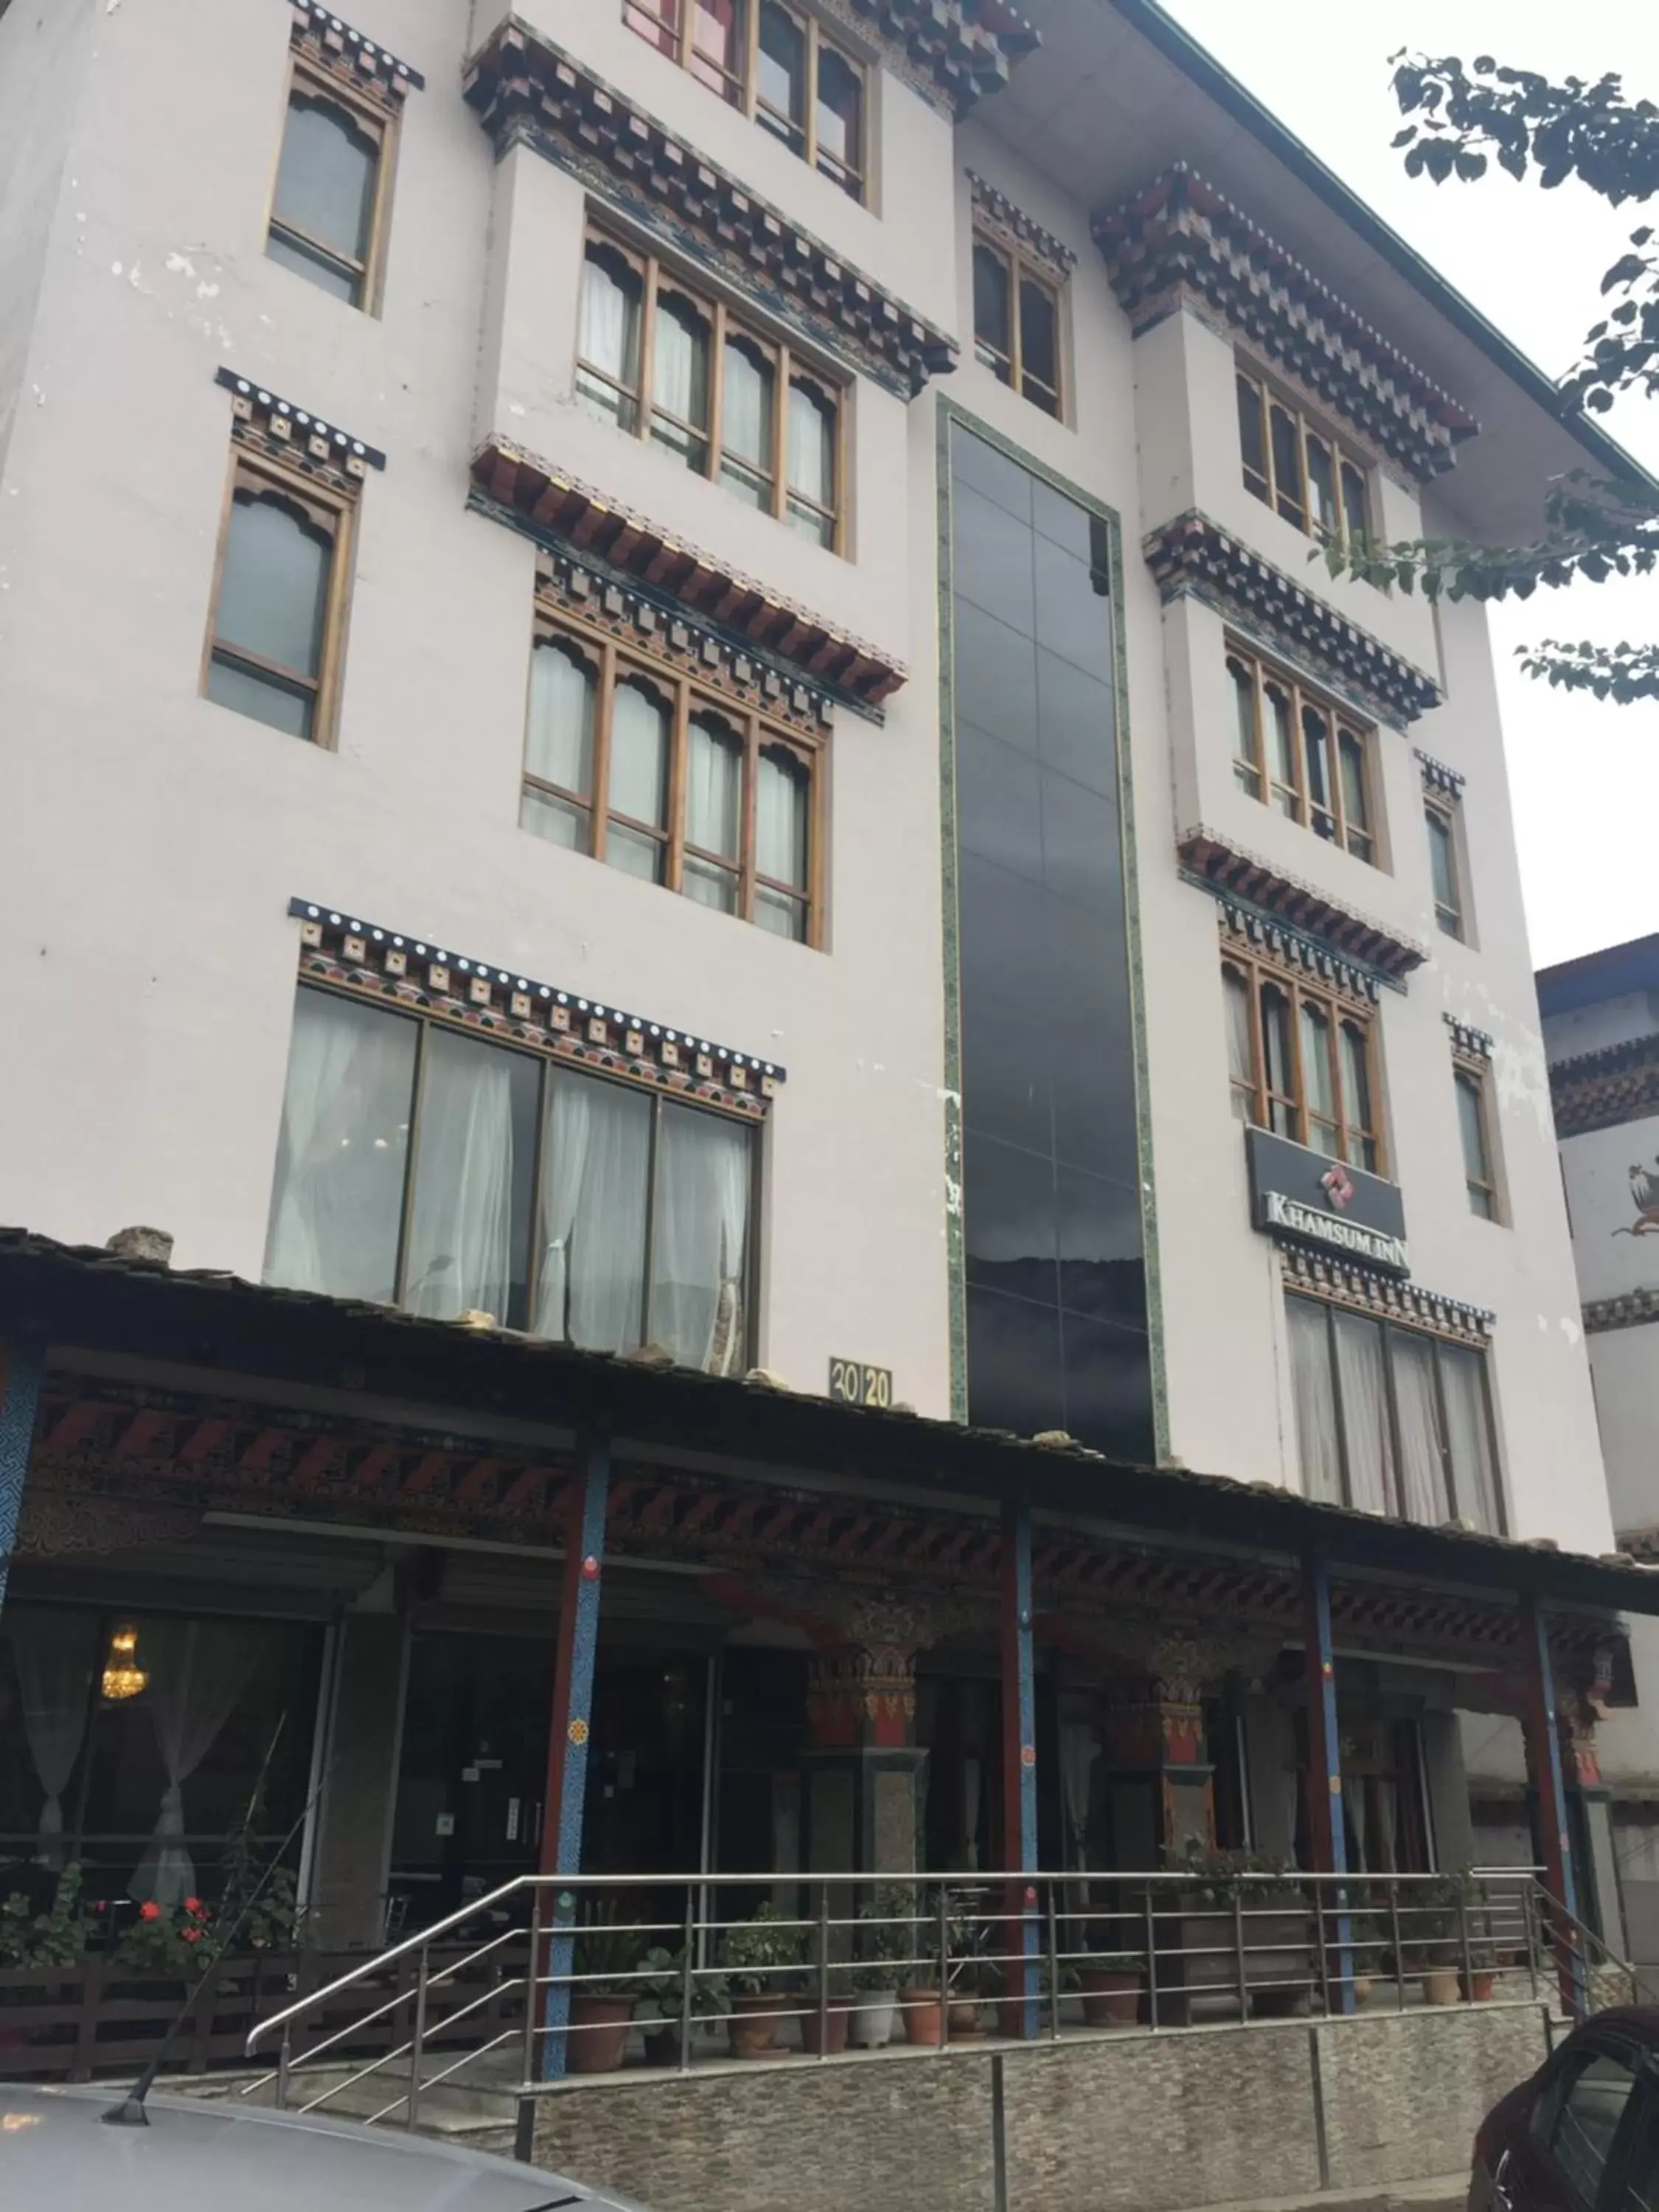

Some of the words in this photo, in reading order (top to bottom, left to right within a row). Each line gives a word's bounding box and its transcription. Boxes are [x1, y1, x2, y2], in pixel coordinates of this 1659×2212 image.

[1266, 1192, 1371, 1255] KHAMSUM
[1371, 1237, 1408, 1268] INN
[865, 1368, 889, 1408] 20
